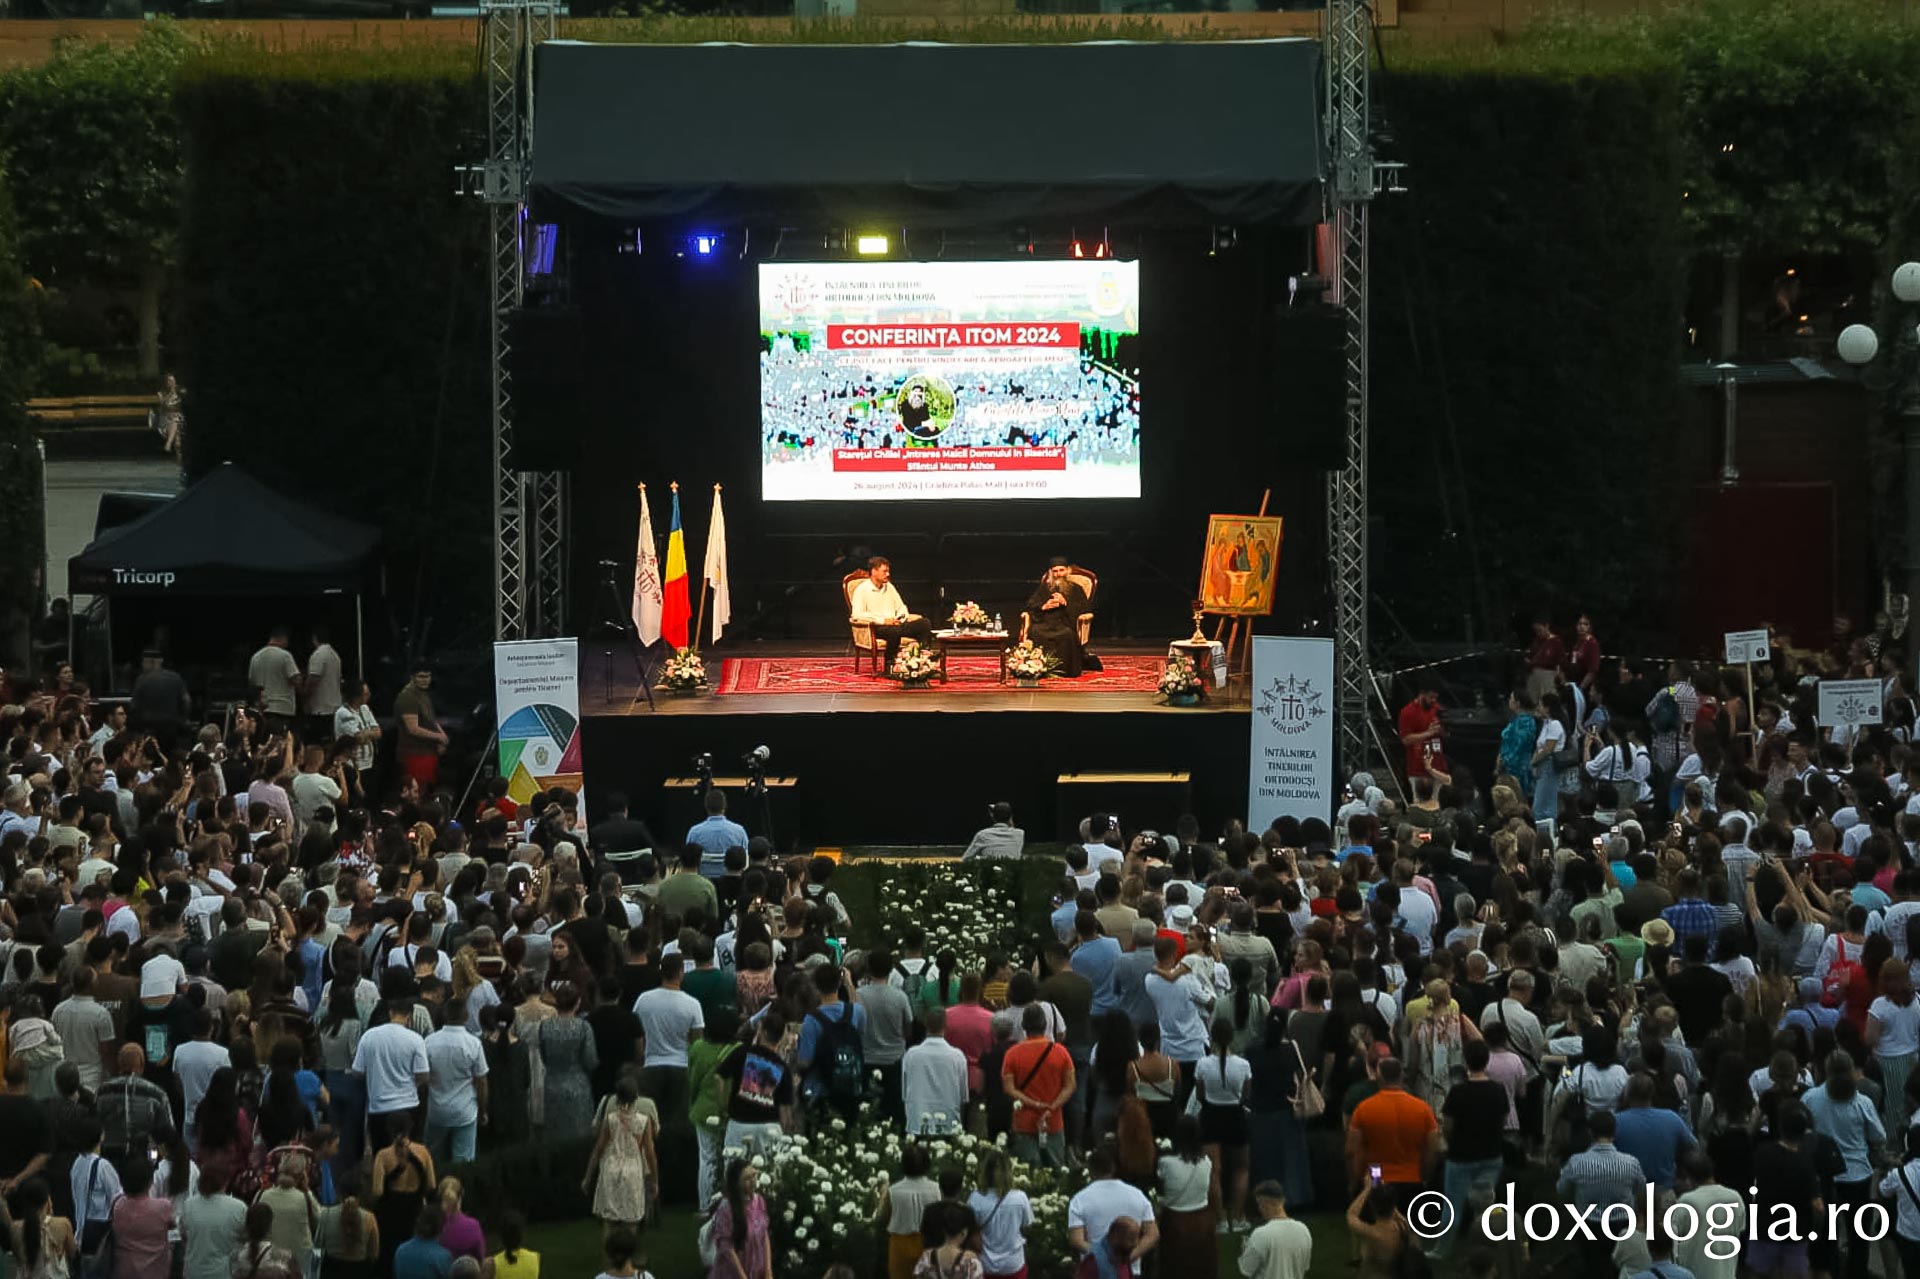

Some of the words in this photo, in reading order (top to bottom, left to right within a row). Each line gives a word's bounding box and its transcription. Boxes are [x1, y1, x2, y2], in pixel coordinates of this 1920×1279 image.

[841, 327, 961, 347] CONFERINȚA
[965, 327, 1010, 345] ITOM
[1016, 326, 1061, 344] 2024
[939, 462, 968, 470] Munte
[969, 461, 995, 470] Athos
[113, 568, 175, 588] Tricorp
[1281, 694, 1305, 720] ITO
[1271, 717, 1312, 735] MOLDOVA
[1268, 761, 1312, 773] TINERILOR
[1259, 787, 1275, 799] DIN
[1276, 788, 1321, 800] MOLDOVA
